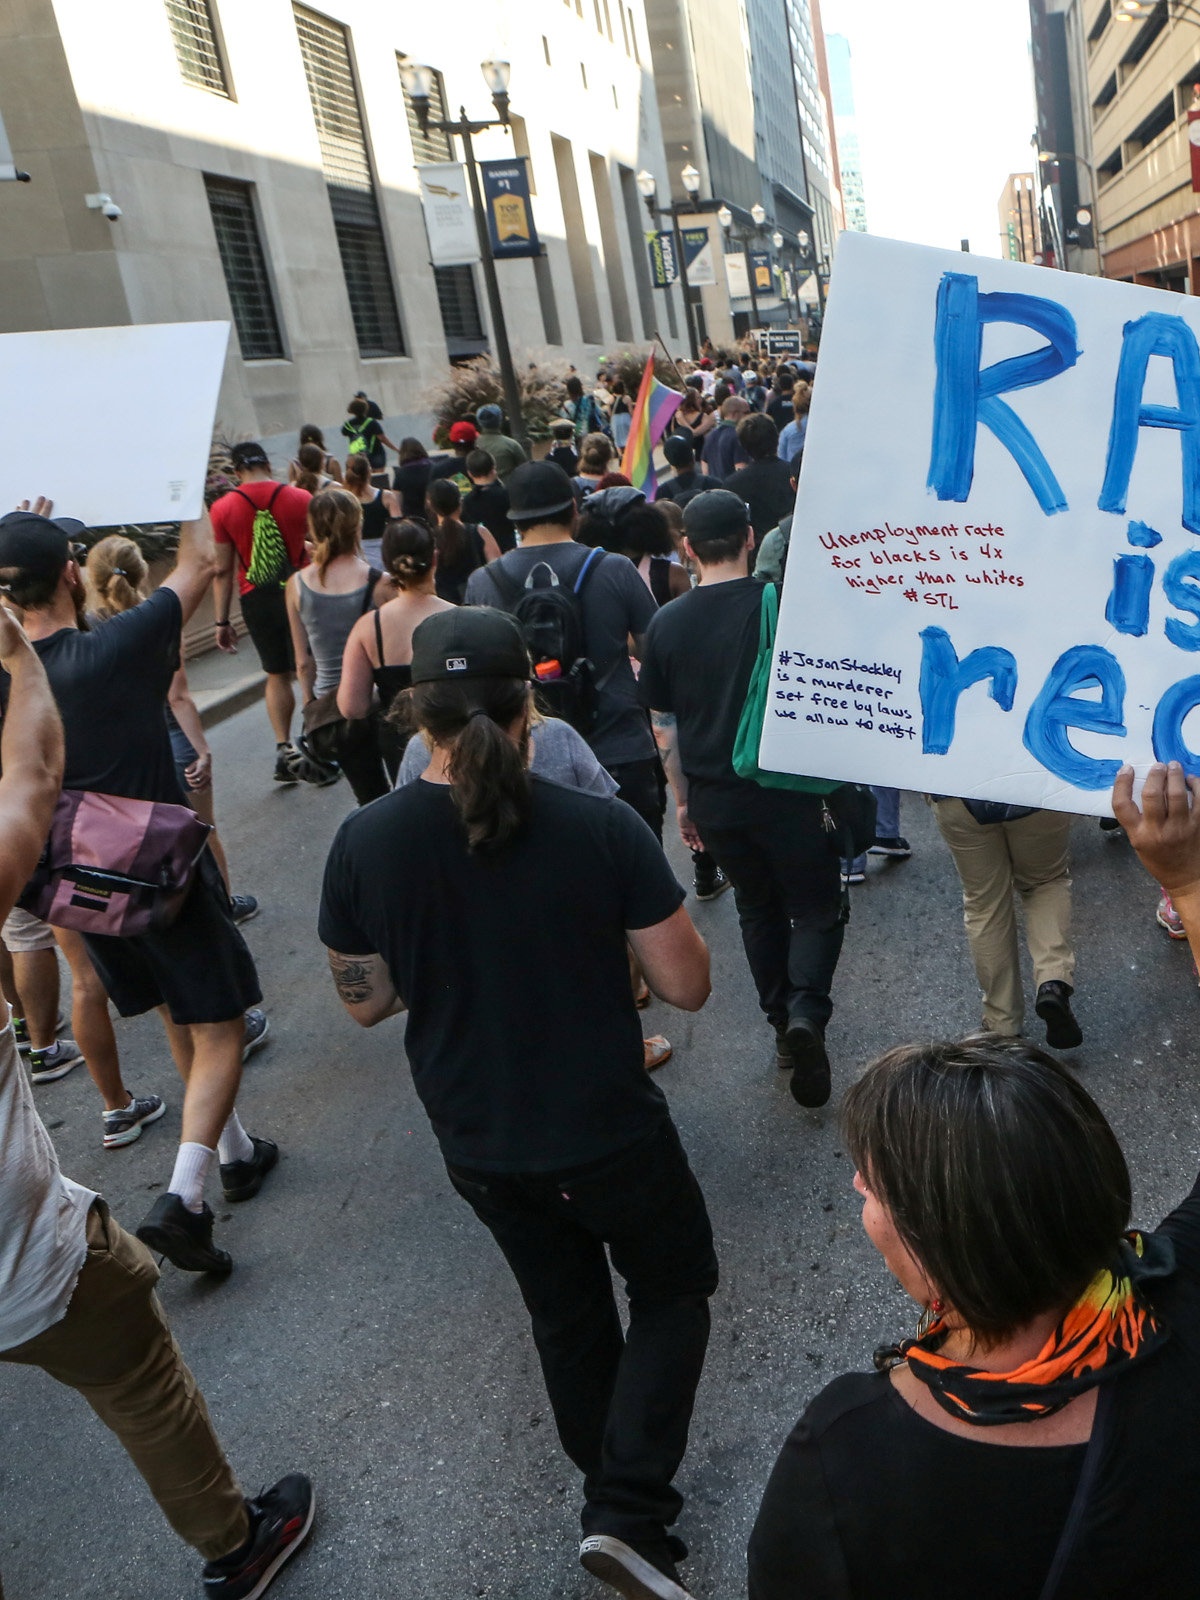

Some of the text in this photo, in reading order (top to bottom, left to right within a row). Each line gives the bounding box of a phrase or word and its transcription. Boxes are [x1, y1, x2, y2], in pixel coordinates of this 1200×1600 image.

[819, 522, 1004, 550] Unemployment rate
[831, 543, 1003, 569] for blacks is 4x
[846, 569, 1024, 594] higher than whites
[777, 669, 893, 699] is a murderer
[776, 690, 912, 719] set free by laws
[775, 709, 916, 740] we allow to exist
